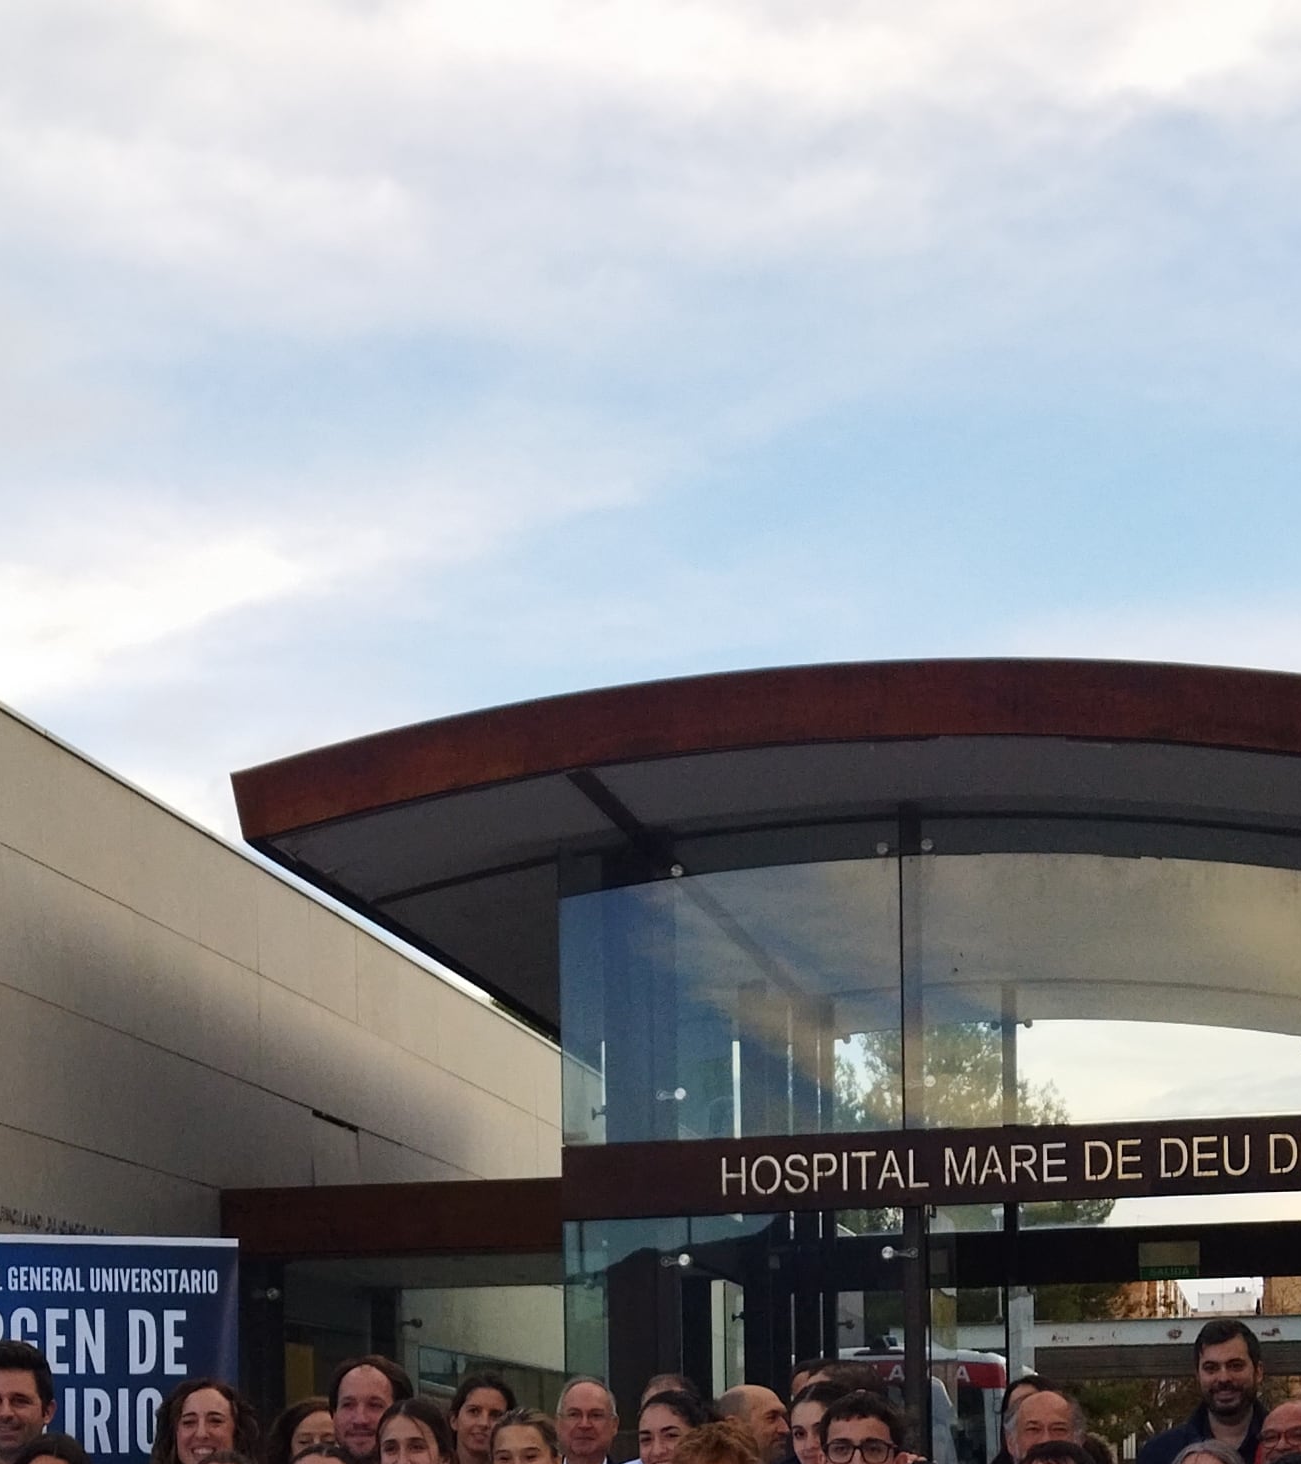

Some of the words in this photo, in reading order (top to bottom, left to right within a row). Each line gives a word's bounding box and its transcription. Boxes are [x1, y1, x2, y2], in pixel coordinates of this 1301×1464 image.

[720, 1149, 929, 1196] HOSPITAL
[943, 1142, 1067, 1186] MARE
[1083, 1138, 1144, 1181] DE
[1159, 1134, 1250, 1178] DEU
[7, 1266, 85, 1292] GENERAL
[90, 1268, 219, 1294] UNIVERSITARIO
[128, 1309, 188, 1376] DE
[42, 1387, 164, 1454] IRIO
